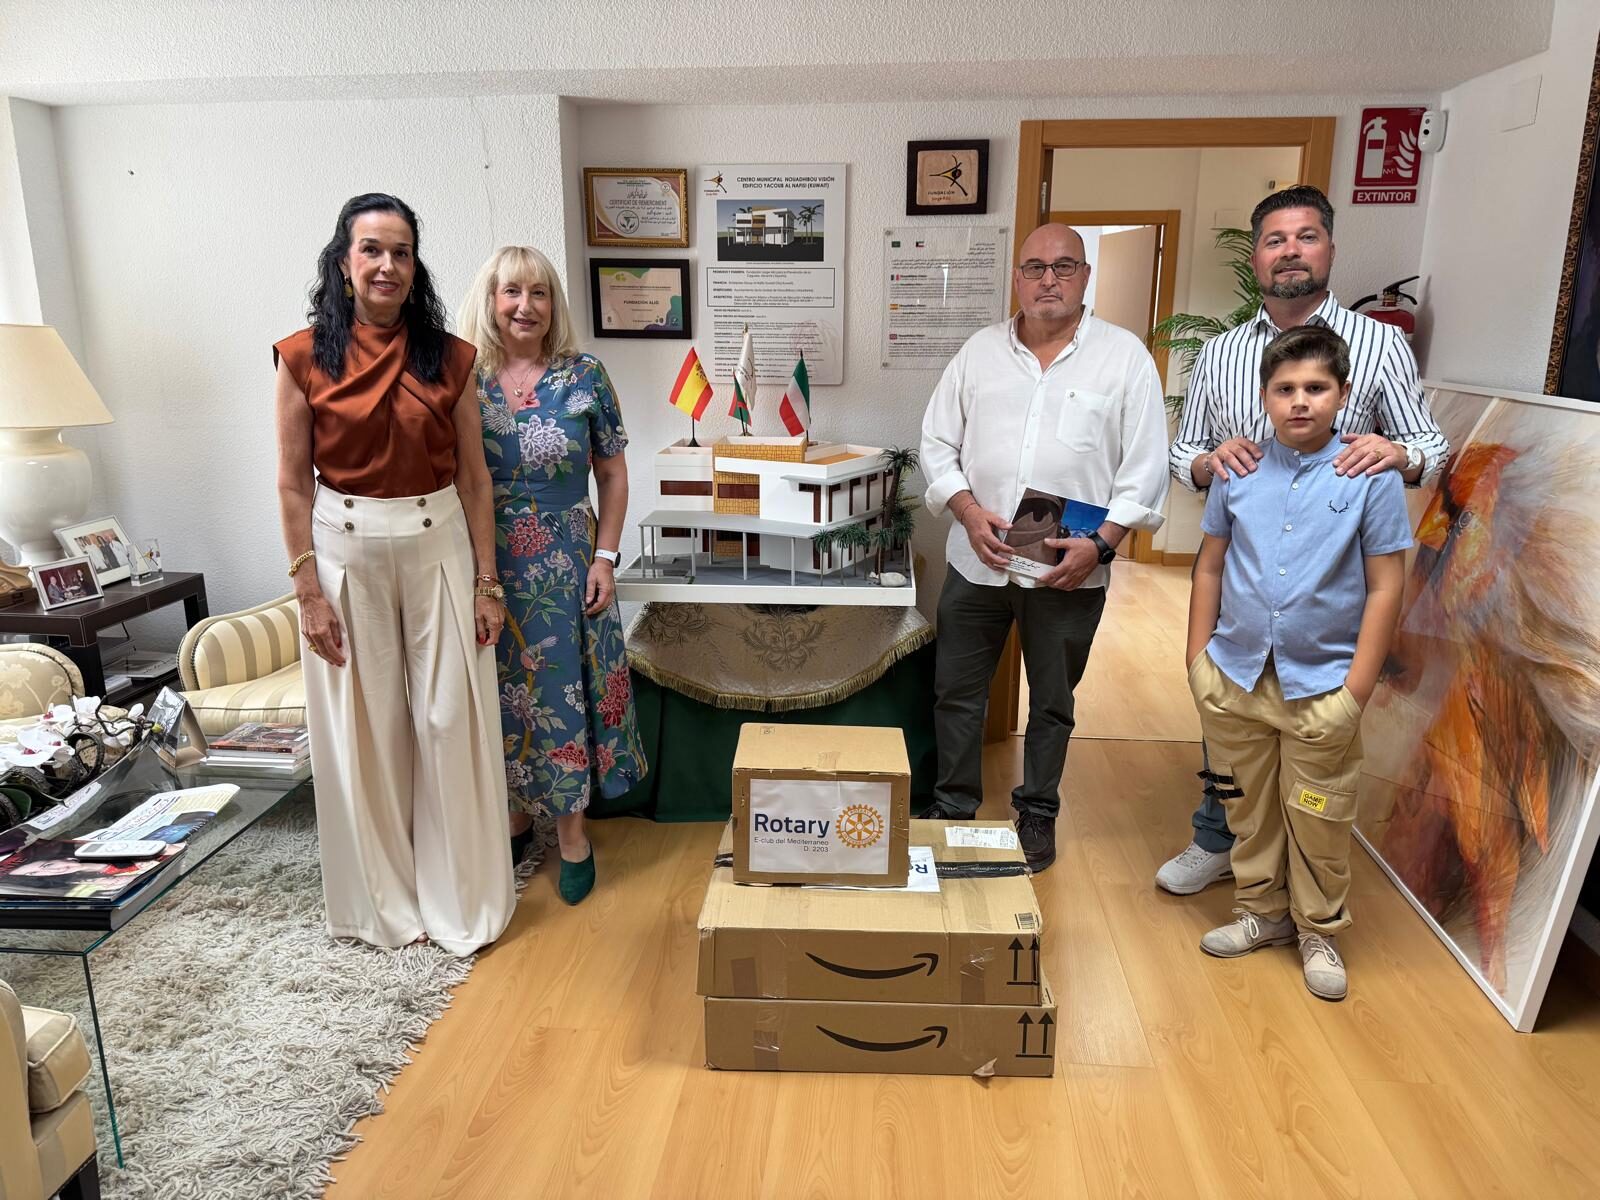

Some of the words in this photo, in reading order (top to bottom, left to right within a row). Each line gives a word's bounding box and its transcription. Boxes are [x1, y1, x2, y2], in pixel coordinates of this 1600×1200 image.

[1357, 191, 1412, 202] EXTINTOR
[1304, 798, 1319, 807] NOW
[754, 813, 830, 838] Rotary
[754, 836, 775, 844] E-club
[786, 838, 829, 846] Mediterraneo
